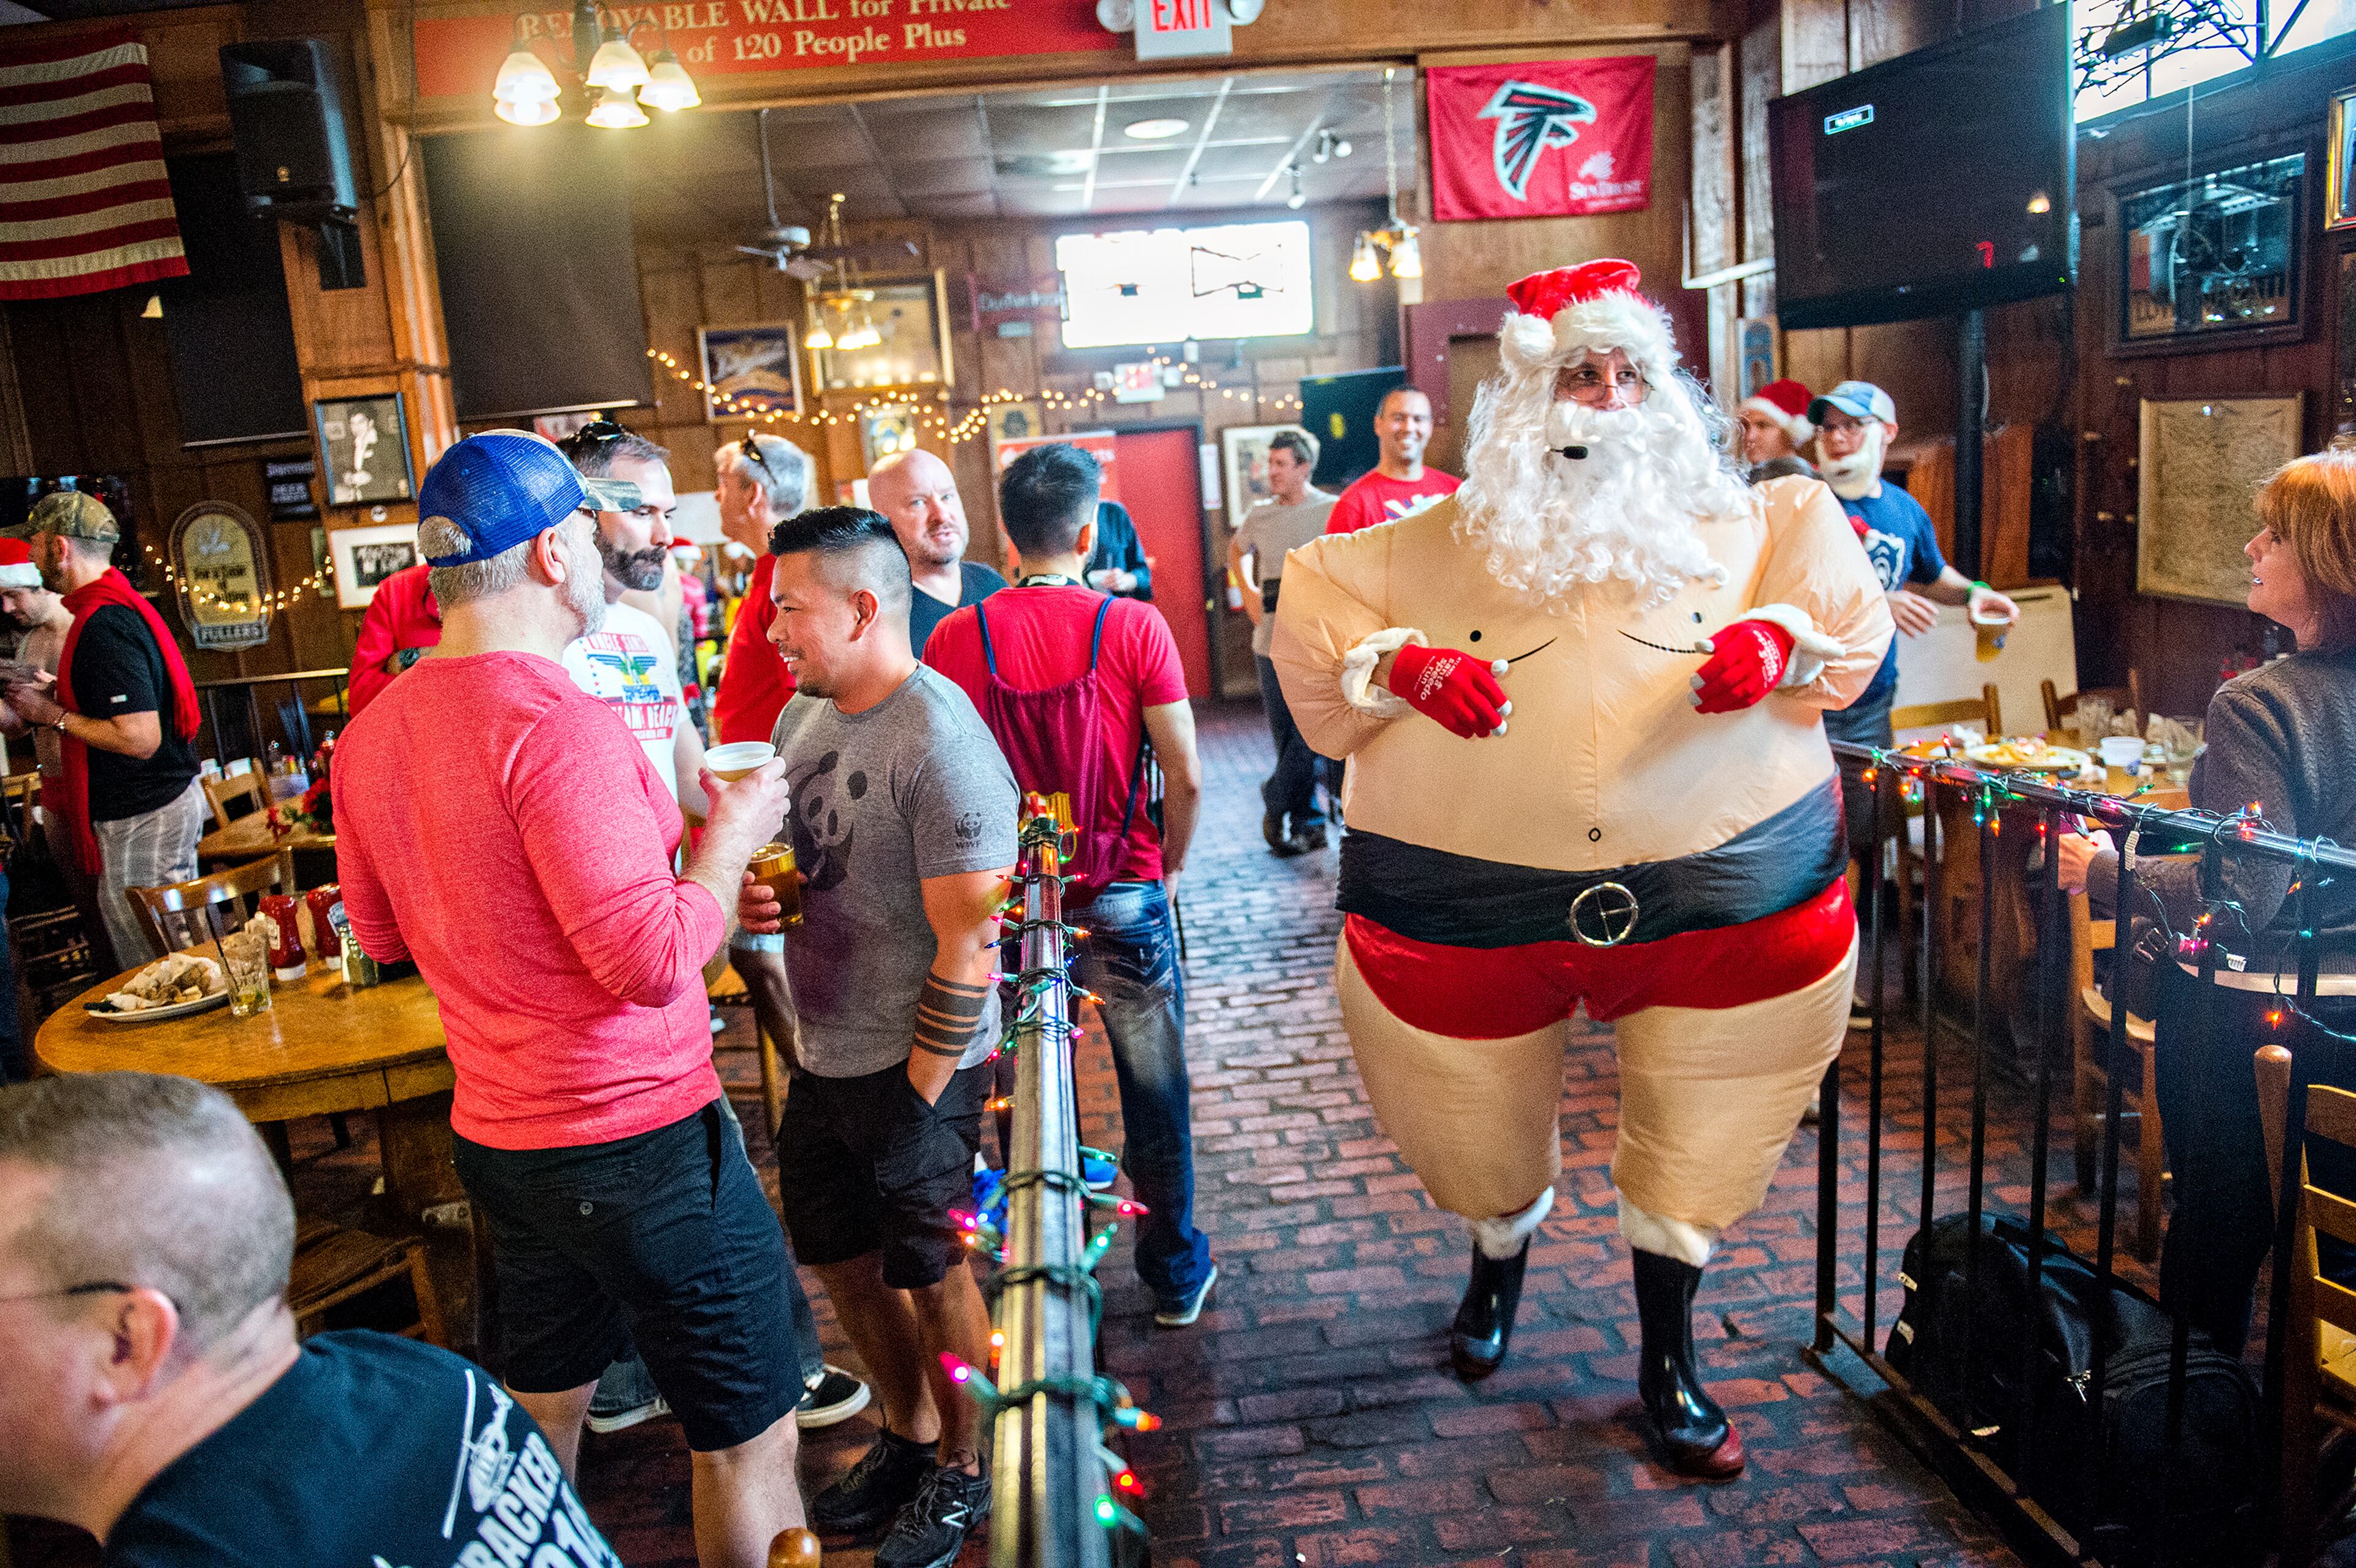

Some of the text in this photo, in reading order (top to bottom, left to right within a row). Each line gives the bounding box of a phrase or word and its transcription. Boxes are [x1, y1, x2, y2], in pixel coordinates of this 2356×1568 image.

[521, 2, 729, 40] REOVABLE
[742, 0, 839, 23] WALL
[851, 0, 893, 18] for
[1150, 0, 1212, 33] EXIT
[687, 36, 717, 63] of
[734, 33, 782, 60] 120
[795, 26, 890, 63] People
[904, 22, 966, 49] Plus
[1420, 658, 1447, 701] speedo
[1421, 666, 1434, 685] run
[955, 840, 982, 850] WWF
